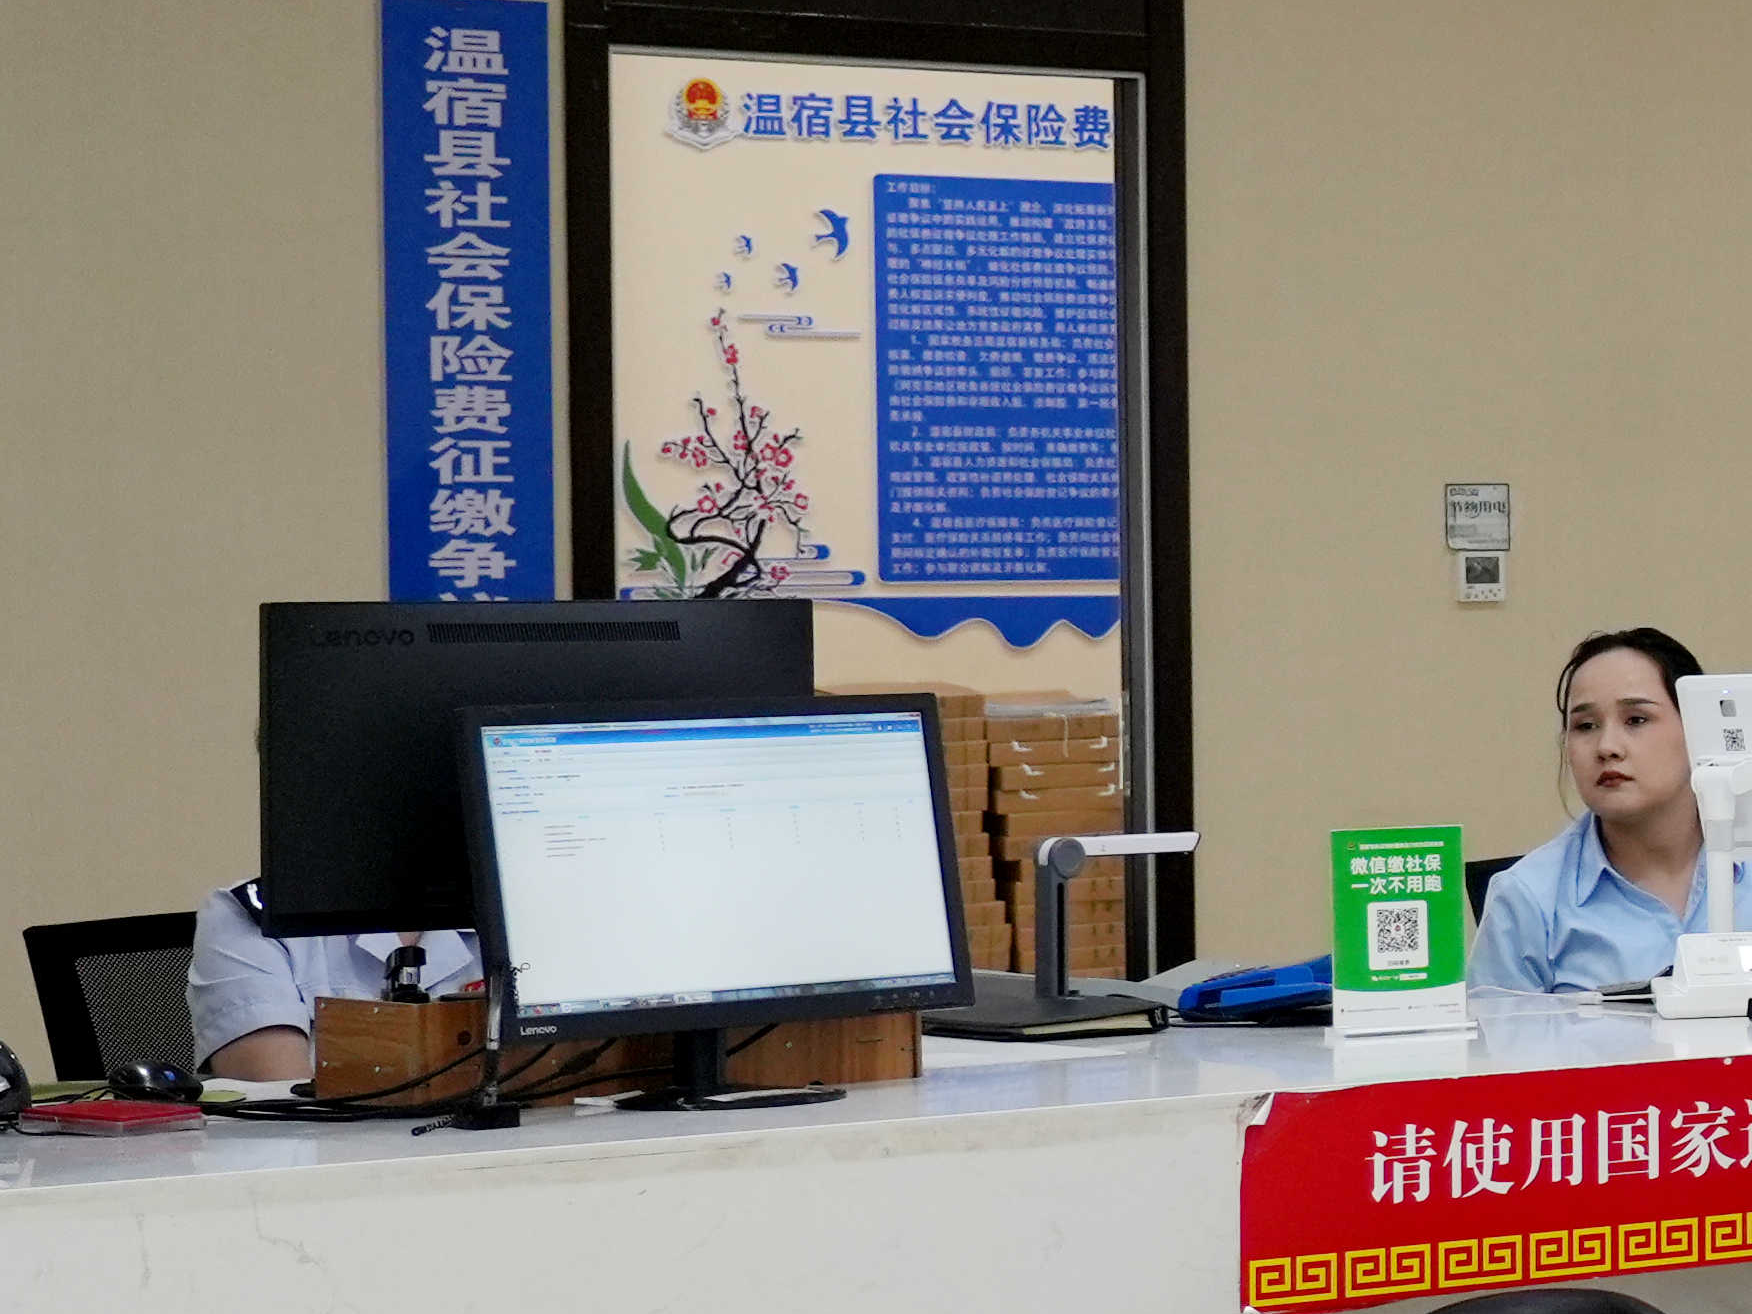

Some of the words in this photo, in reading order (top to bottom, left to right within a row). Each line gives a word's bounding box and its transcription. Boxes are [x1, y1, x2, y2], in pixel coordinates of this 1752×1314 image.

[741, 91, 1111, 150] 温宿县社会保险费
[423, 25, 517, 601] 温宿县社会保险费征缴争
[1350, 853, 1442, 875] 微信缴社保
[1351, 874, 1442, 894] 一次不用跑
[520, 1023, 557, 1036] Lenovo
